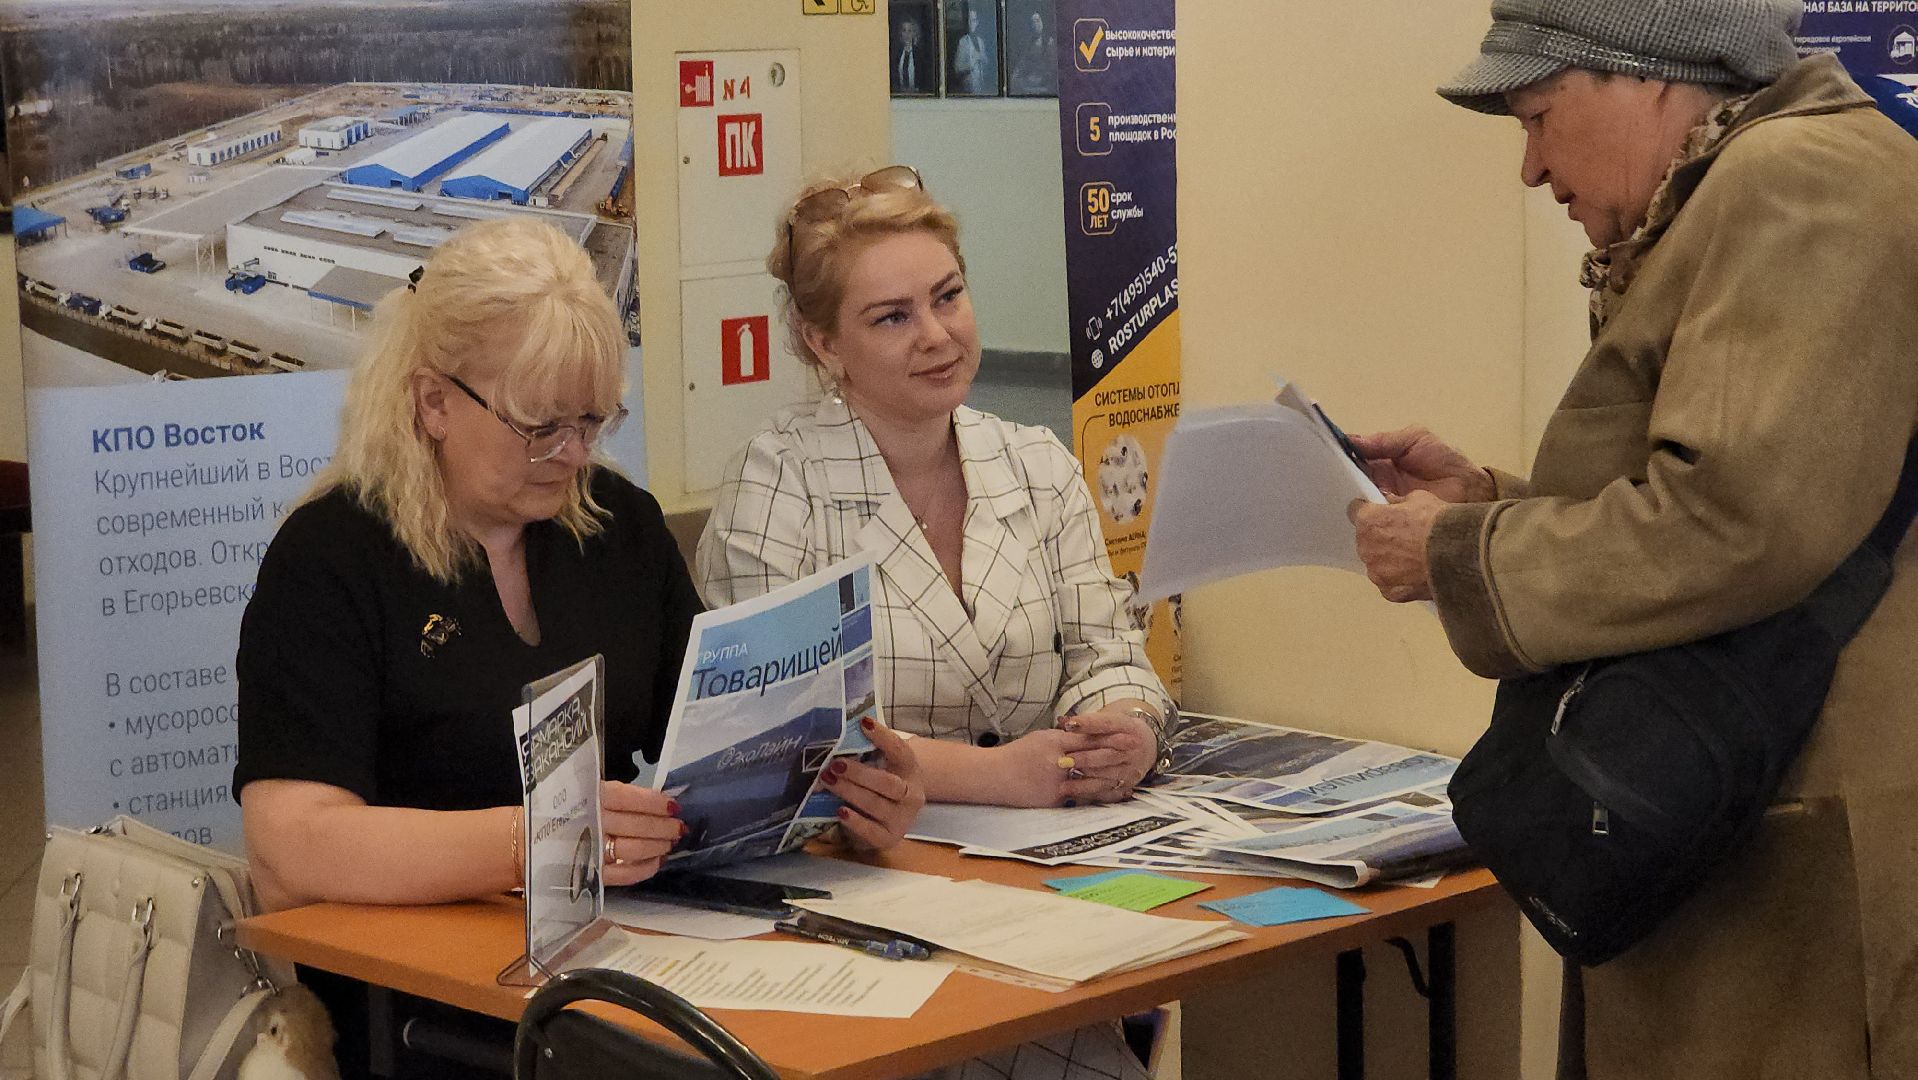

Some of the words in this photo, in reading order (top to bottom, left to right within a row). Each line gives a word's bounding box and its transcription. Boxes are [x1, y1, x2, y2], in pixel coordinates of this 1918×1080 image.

[1827, 1, 1853, 13] БАЗА
[1855, 1, 1870, 13] НА
[1871, 1, 1918, 13] ТЕРРИТО
[1105, 30, 1176, 40] высококачестве
[1106, 46, 1134, 60] сырье
[1135, 46, 1141, 57] и
[740, 75, 750, 99] 4
[1089, 116, 1100, 141] 5
[1109, 130, 1152, 143] площадок
[1153, 130, 1159, 140] в
[725, 121, 757, 168] ПК
[1087, 188, 1110, 213] 50
[1110, 191, 1133, 206] срок
[1089, 214, 1109, 229] ЛЕТ
[1110, 205, 1144, 222] службы
[1105, 241, 1177, 320] +7(495)540-5
[1107, 278, 1178, 355] ROSTURPLAS
[1095, 386, 1146, 407] СИСТЕМЫ
[1108, 402, 1180, 428] ВОДОСНАБЖЕ
[92, 425, 155, 453] КПО
[164, 421, 265, 448] Восток
[95, 457, 249, 500] Крупнейший
[258, 461, 270, 481] в
[97, 496, 264, 537] современный
[99, 549, 203, 576] отходов.
[102, 597, 116, 617] в
[692, 624, 843, 700] Товарищей
[106, 672, 121, 697] В
[129, 666, 227, 694] составе
[521, 696, 581, 765] ЯРМАРКА
[524, 709, 589, 786] ВАКАНСИЙ
[110, 758, 122, 777] с
[128, 785, 228, 815] станция
